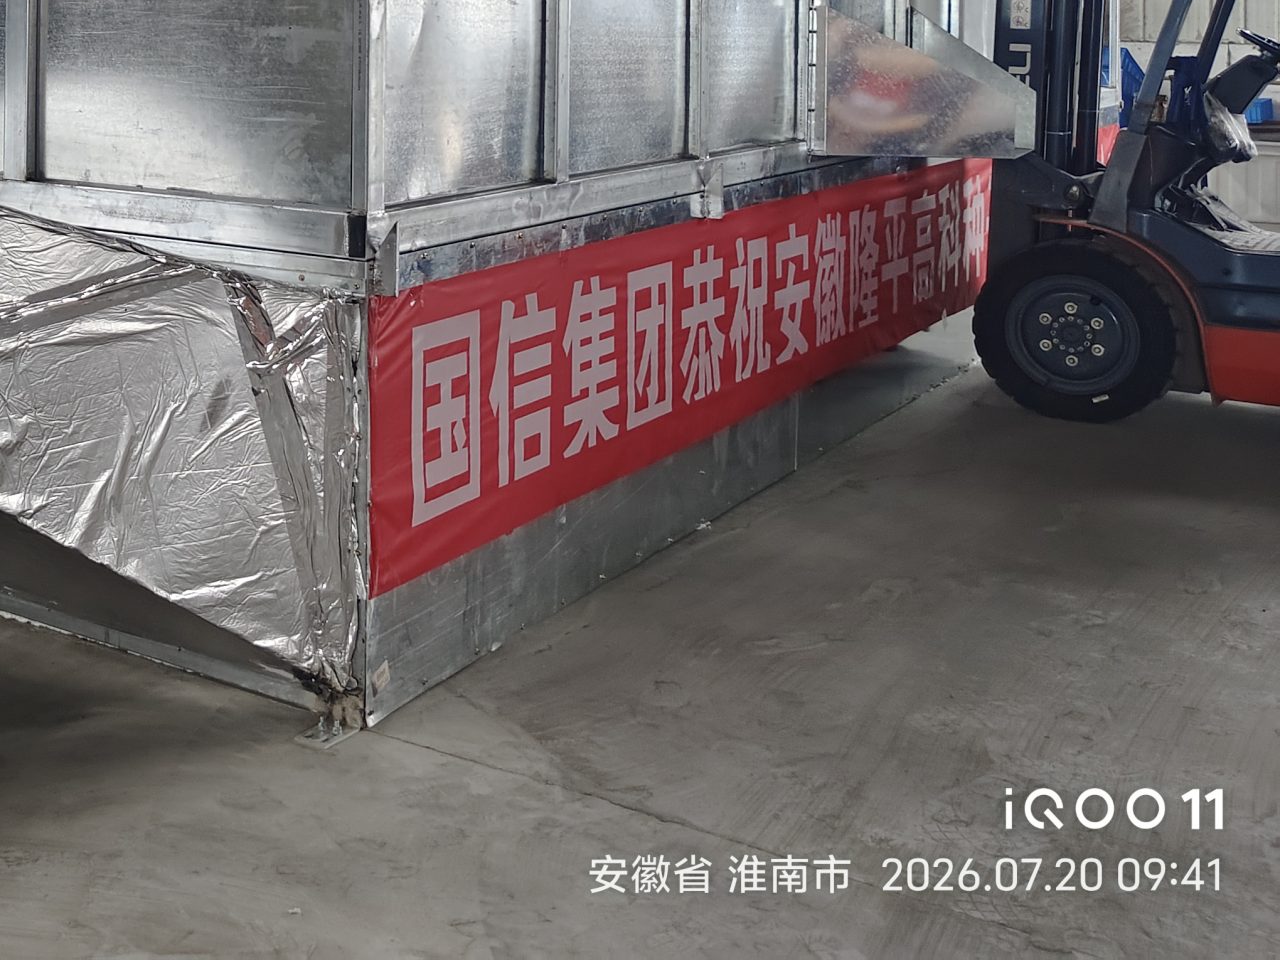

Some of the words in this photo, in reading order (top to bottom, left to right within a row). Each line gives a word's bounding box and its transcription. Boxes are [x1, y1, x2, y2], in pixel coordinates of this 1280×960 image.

[1008, 43, 1032, 88] LI
[411, 173, 991, 527] 国信集团恭祝安徽隆平高科种
